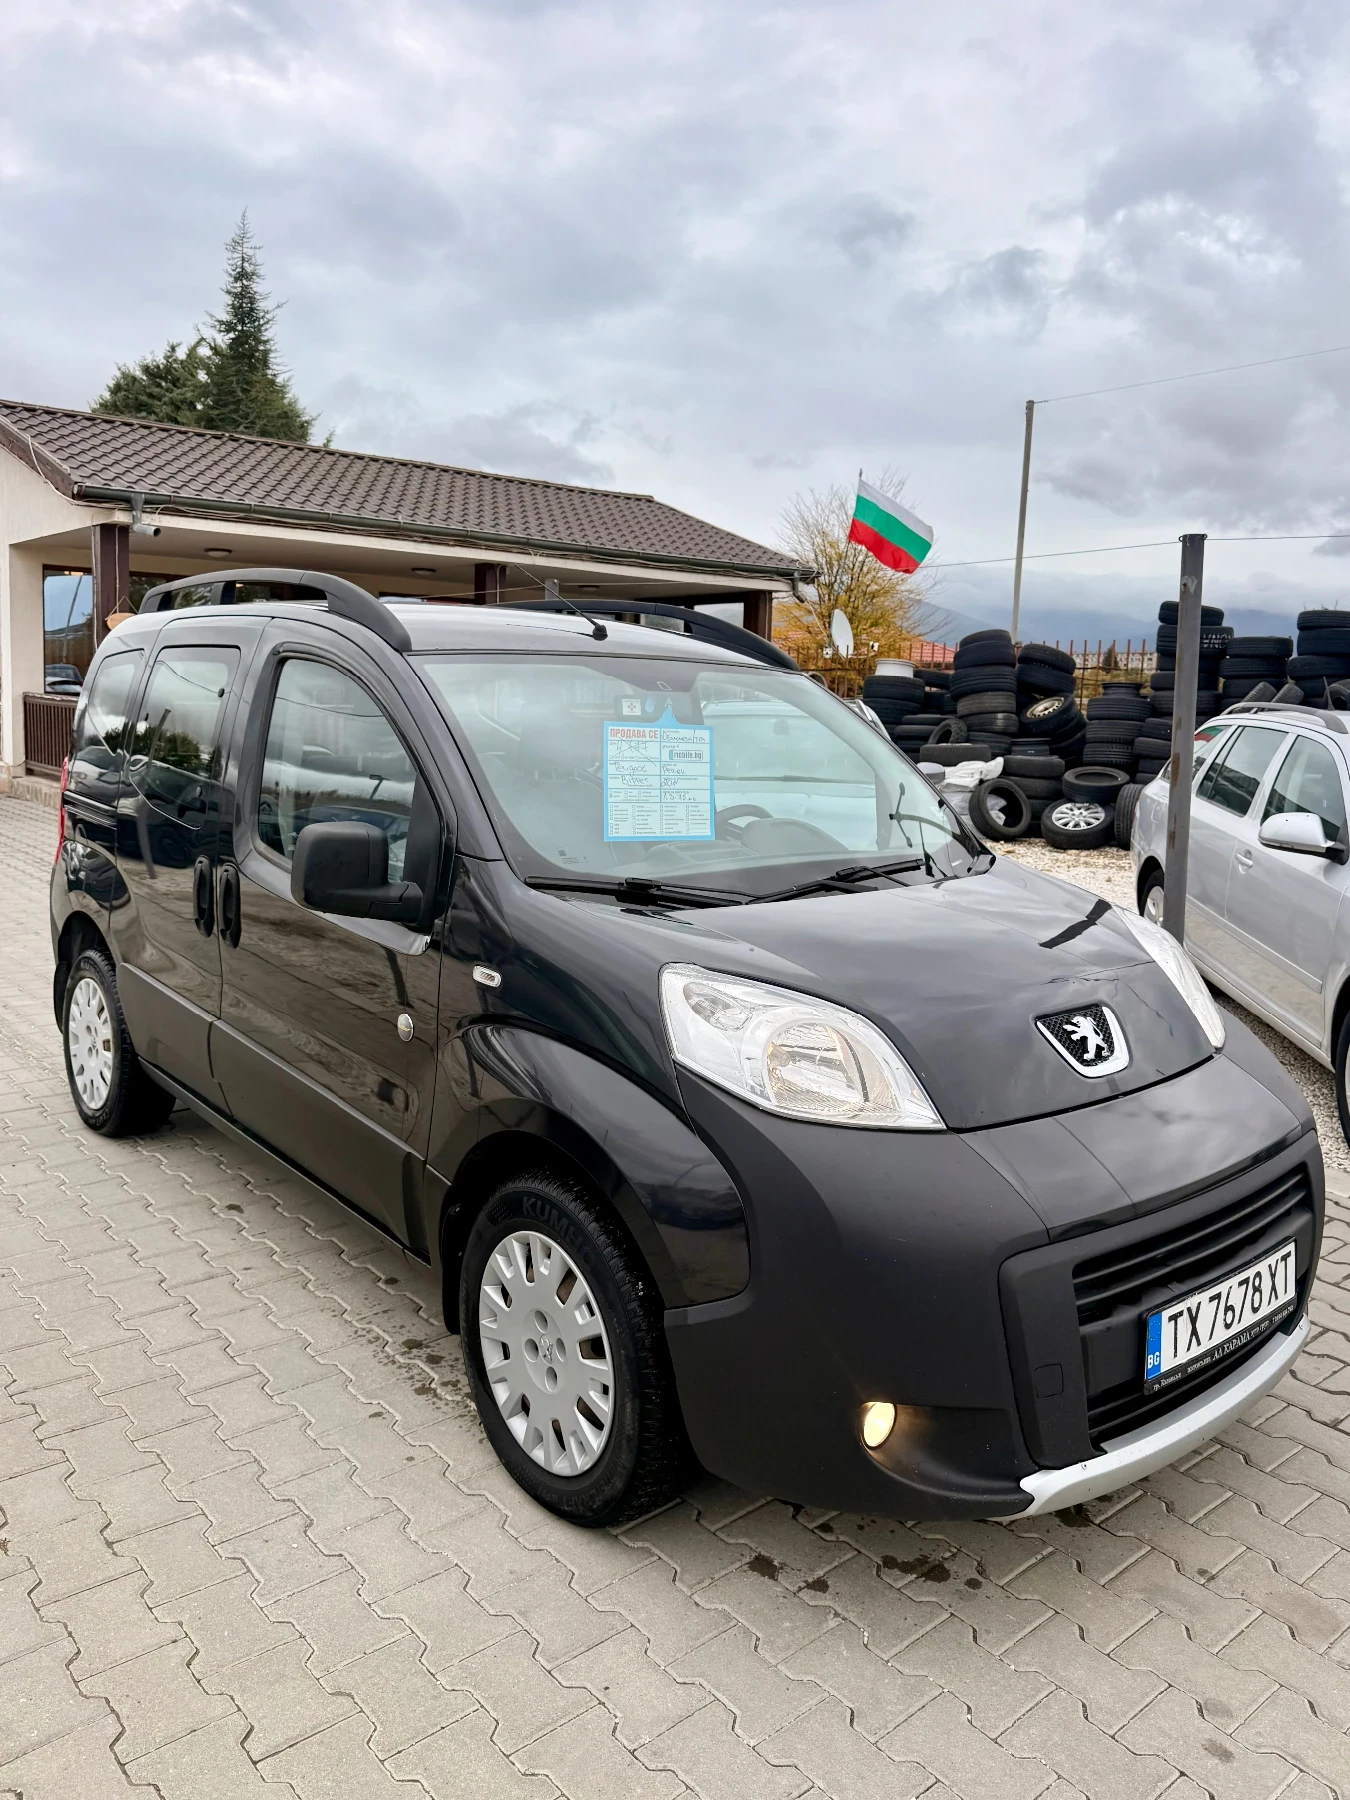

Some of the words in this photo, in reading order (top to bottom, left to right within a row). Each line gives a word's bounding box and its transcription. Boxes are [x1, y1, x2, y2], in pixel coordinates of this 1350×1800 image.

[610, 728, 647, 739] ПРОДАВА
[648, 729, 659, 739] СЕ
[673, 751, 702, 760] mobile.bg
[522, 1196, 596, 1270] KUMHO
[1168, 1301, 1202, 1359] TX
[1208, 1270, 1263, 1341] 7678
[1267, 1250, 1292, 1307] XT
[1147, 1351, 1160, 1370] BG
